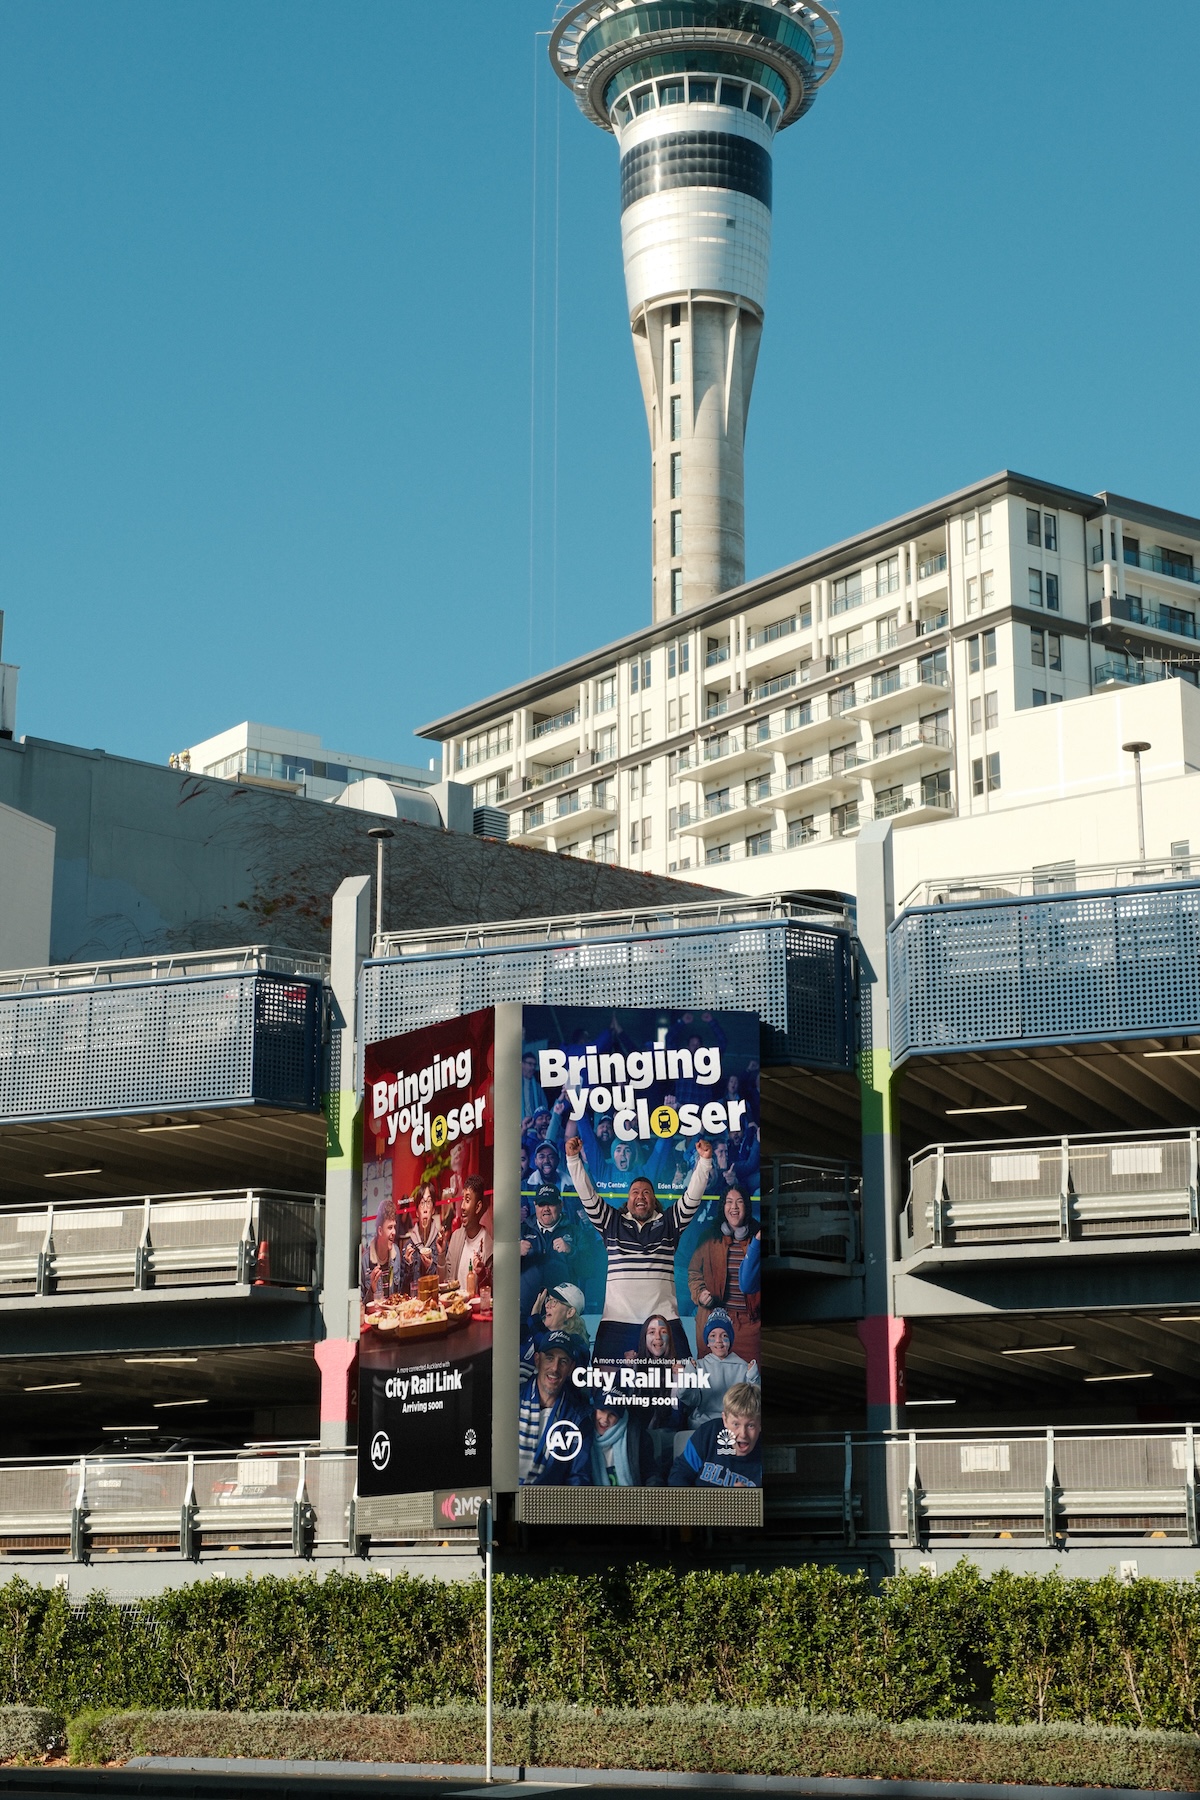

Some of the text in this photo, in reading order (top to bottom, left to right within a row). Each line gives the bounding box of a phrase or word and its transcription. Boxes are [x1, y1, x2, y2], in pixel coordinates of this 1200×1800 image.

[538, 1042, 721, 1090] Bringing
[373, 1048, 472, 1119] Bringing
[567, 1085, 635, 1121] you
[387, 1101, 424, 1145] you
[595, 1181, 626, 1189] City Centre
[616, 1357, 647, 1365] connected
[385, 1369, 463, 1400] City Rail Link
[572, 1366, 711, 1392] City Rail Link
[899, 1370, 904, 1387] 2
[351, 1389, 357, 1405] 2
[402, 1400, 444, 1413] Arriving soon
[604, 1394, 678, 1407] Arriving soon
